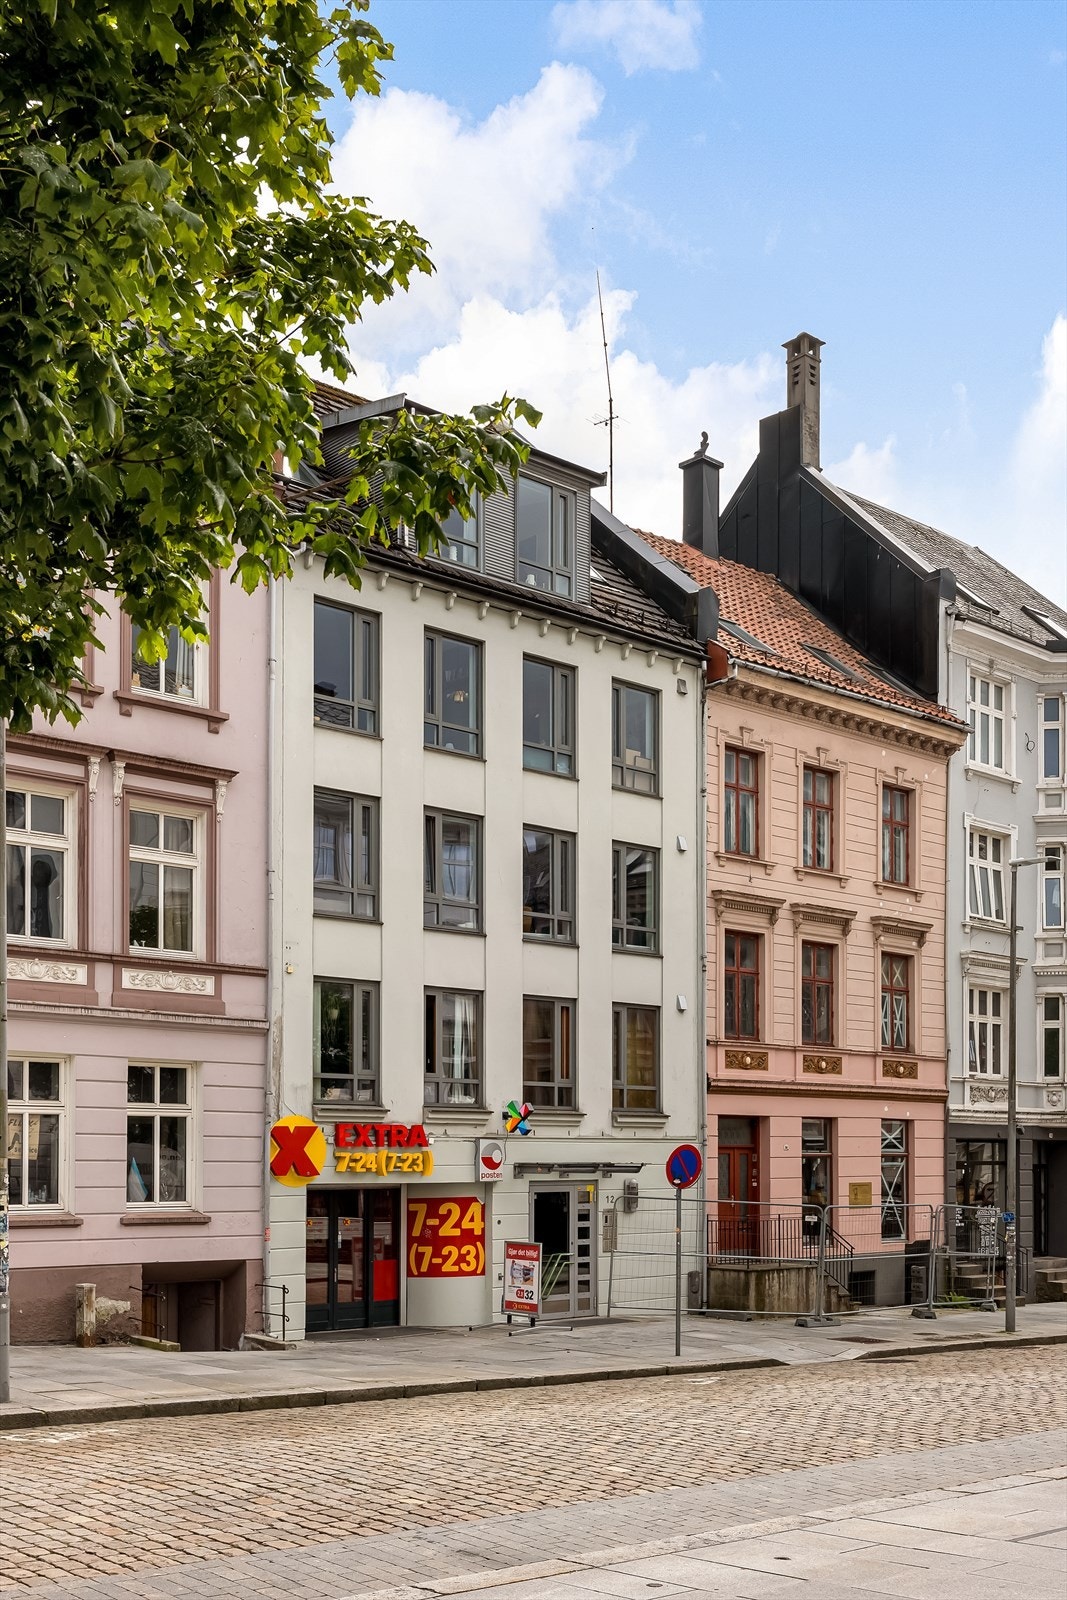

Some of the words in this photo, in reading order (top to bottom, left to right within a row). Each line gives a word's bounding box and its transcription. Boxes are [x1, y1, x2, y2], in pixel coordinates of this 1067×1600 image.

[335, 1124, 429, 1147] EXTRA
[335, 1152, 377, 1172] 7-24
[376, 1150, 433, 1176] (7-23)
[606, 1195, 615, 1204] 12
[408, 1202, 485, 1237] 7-24
[409, 1241, 485, 1275] (7-23)
[525, 1290, 534, 1300] 32
